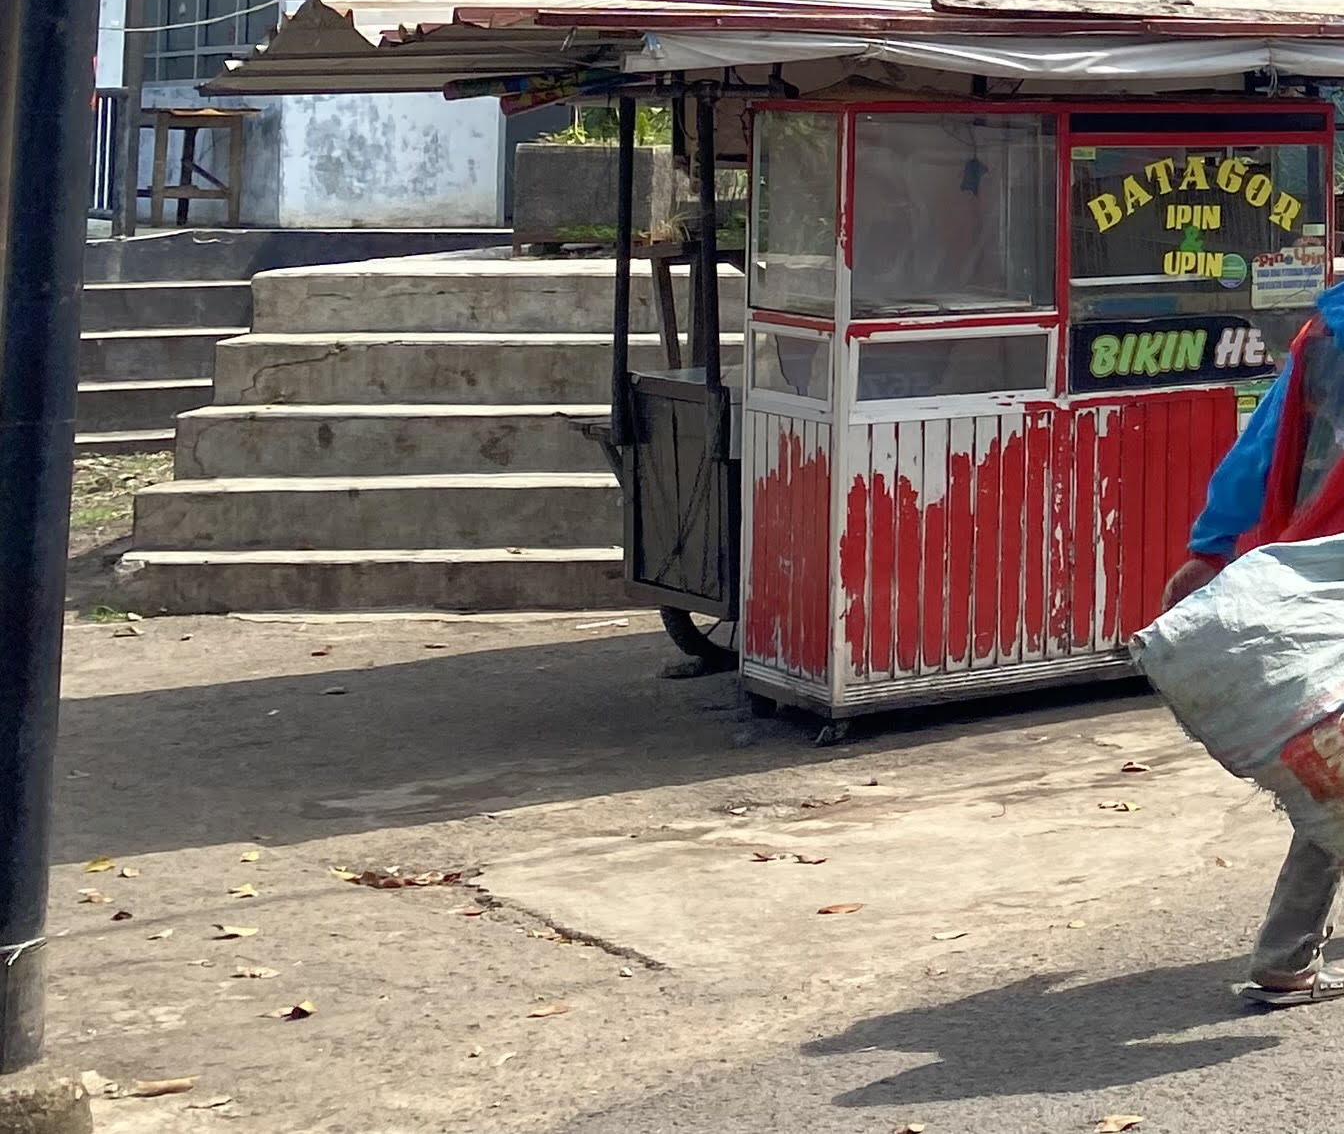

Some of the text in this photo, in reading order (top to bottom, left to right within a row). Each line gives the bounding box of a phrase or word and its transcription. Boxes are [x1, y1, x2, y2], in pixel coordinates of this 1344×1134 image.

[1087, 156, 1302, 233] BATAGOR
[1166, 205, 1221, 230] IPIN
[1163, 252, 1224, 277] UPIN
[1090, 327, 1275, 378] BIKIN HE
